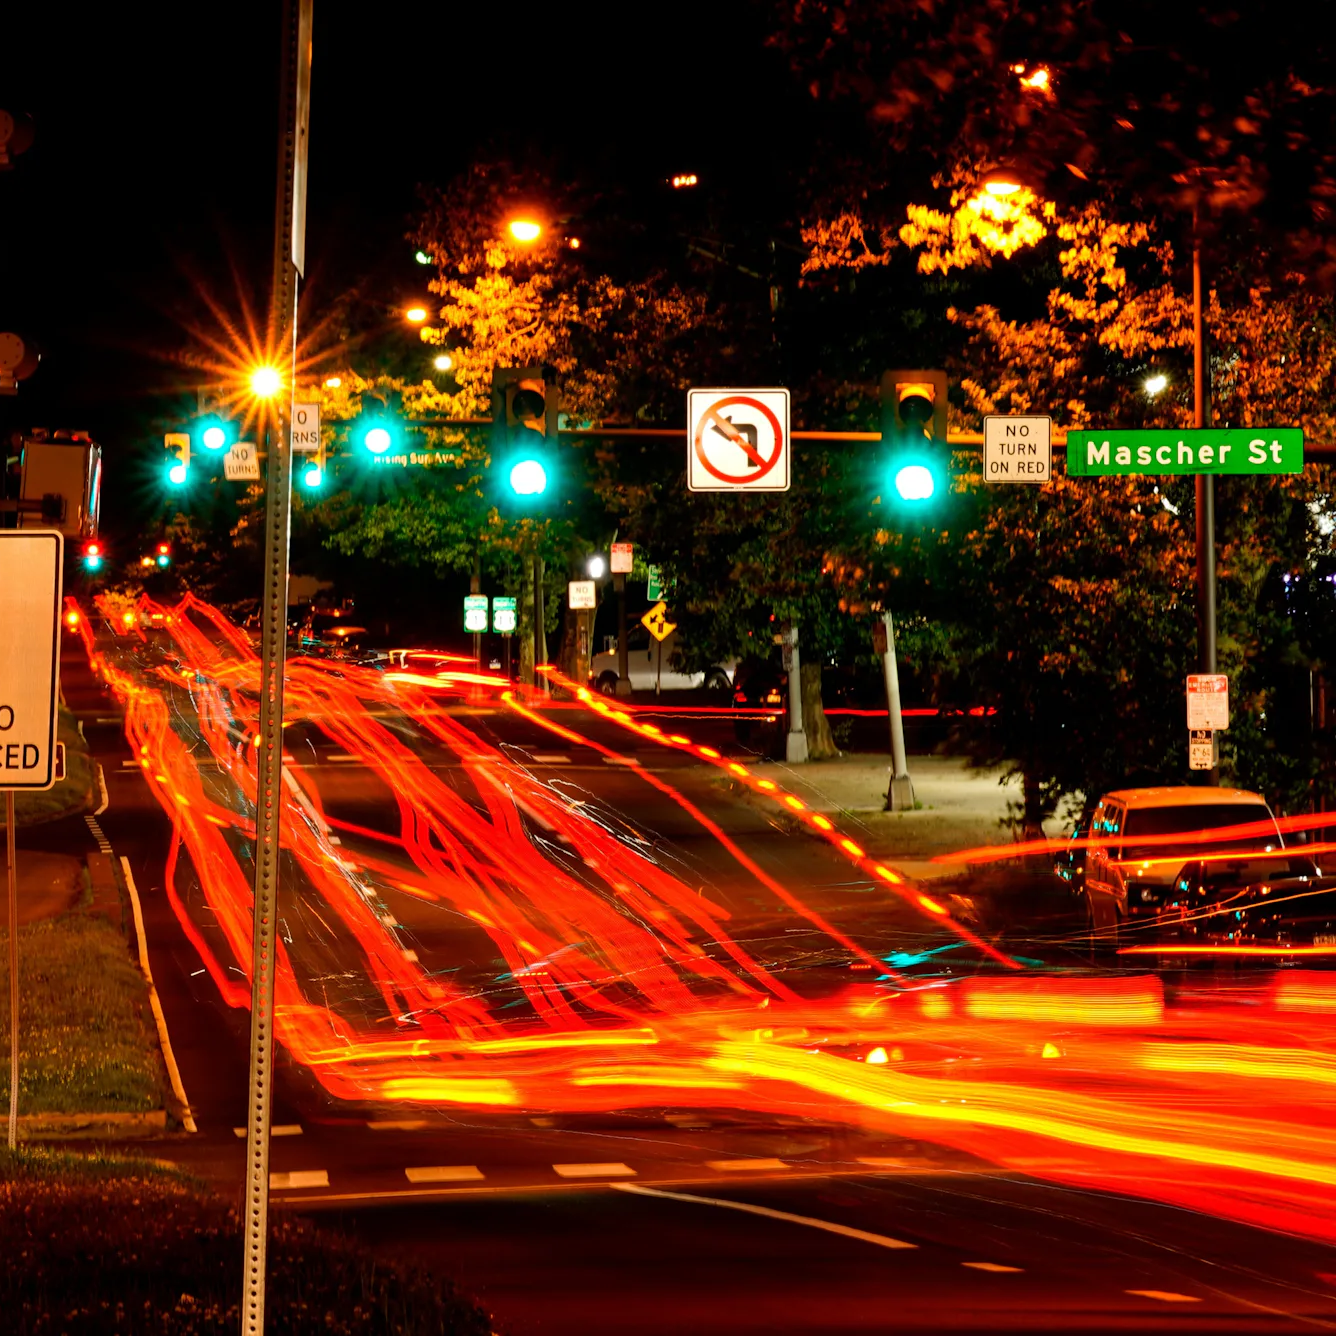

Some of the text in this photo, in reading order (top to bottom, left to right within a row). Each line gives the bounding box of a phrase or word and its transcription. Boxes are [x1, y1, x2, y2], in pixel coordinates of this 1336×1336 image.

[292, 431, 318, 444] RNS
[1005, 425, 1030, 438] NO
[231, 447, 249, 461] NO
[998, 443, 1038, 456] TURN
[1086, 439, 1283, 466] Mascher St
[227, 463, 258, 475] TURNS
[990, 461, 1046, 475] ON RED
[575, 586, 589, 594] NO
